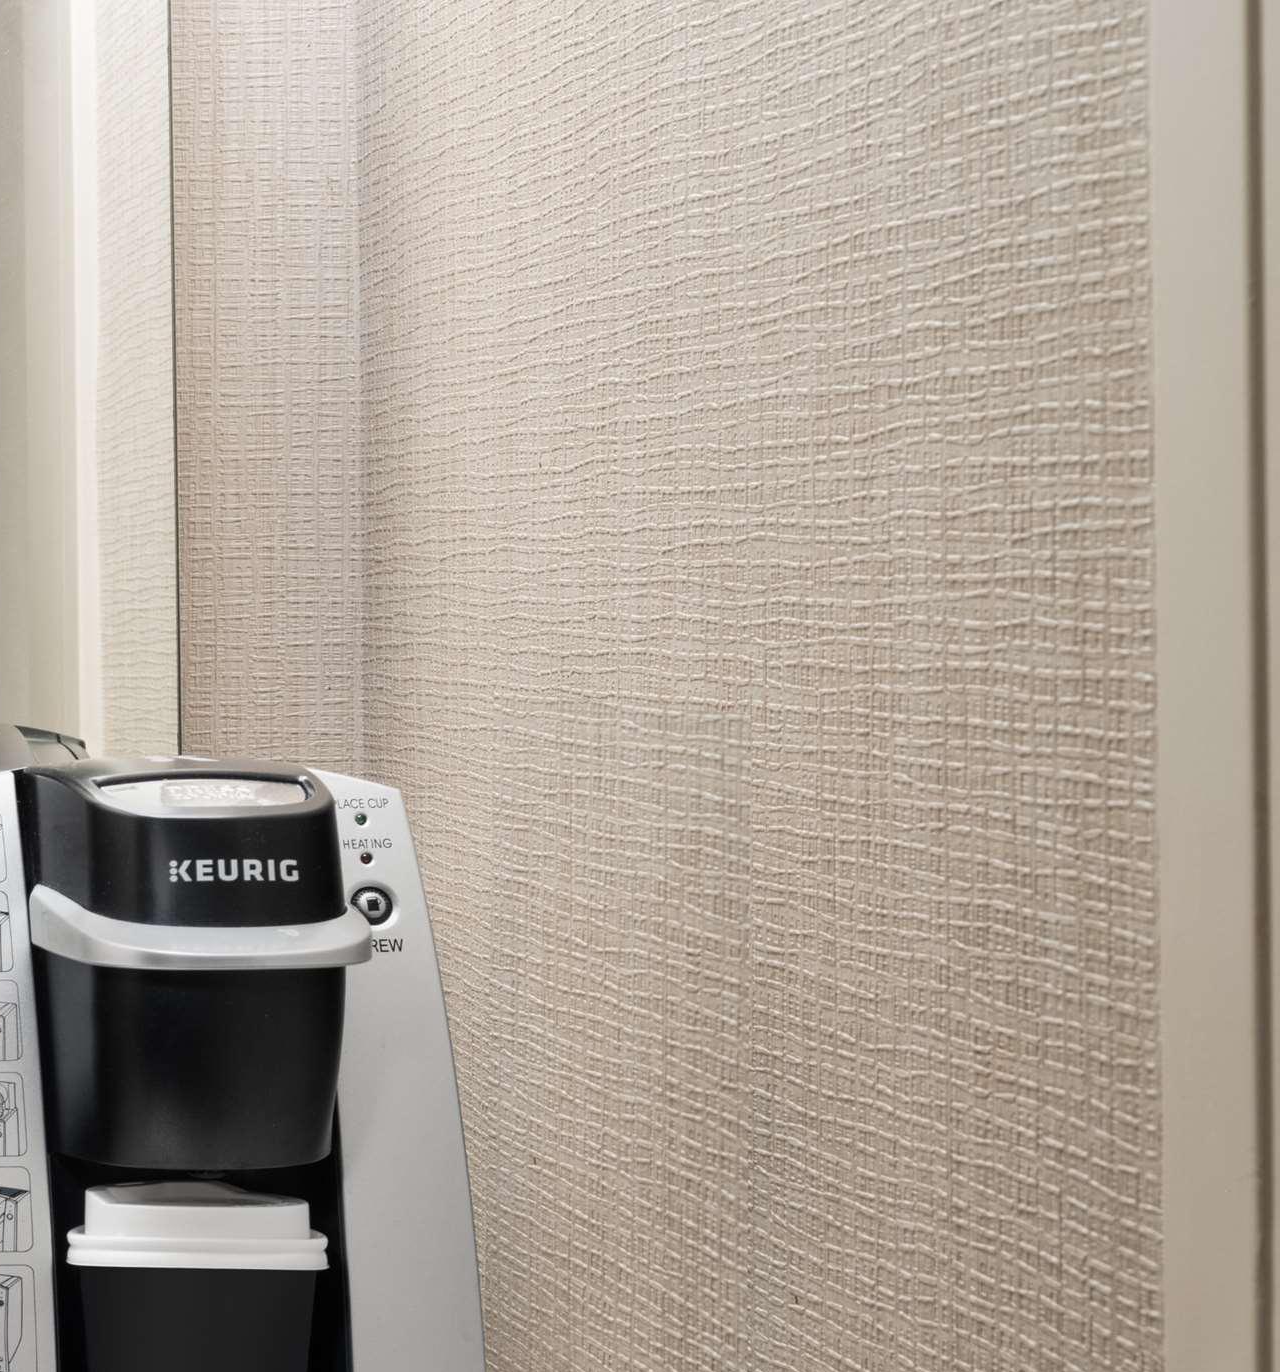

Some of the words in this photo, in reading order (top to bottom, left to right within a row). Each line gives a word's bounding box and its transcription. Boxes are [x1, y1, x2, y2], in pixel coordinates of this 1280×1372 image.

[337, 799, 364, 809] LACE
[367, 799, 389, 809] CUP
[342, 838, 393, 850] HEATING
[169, 859, 299, 882] KEURIG
[371, 938, 404, 953] REW
